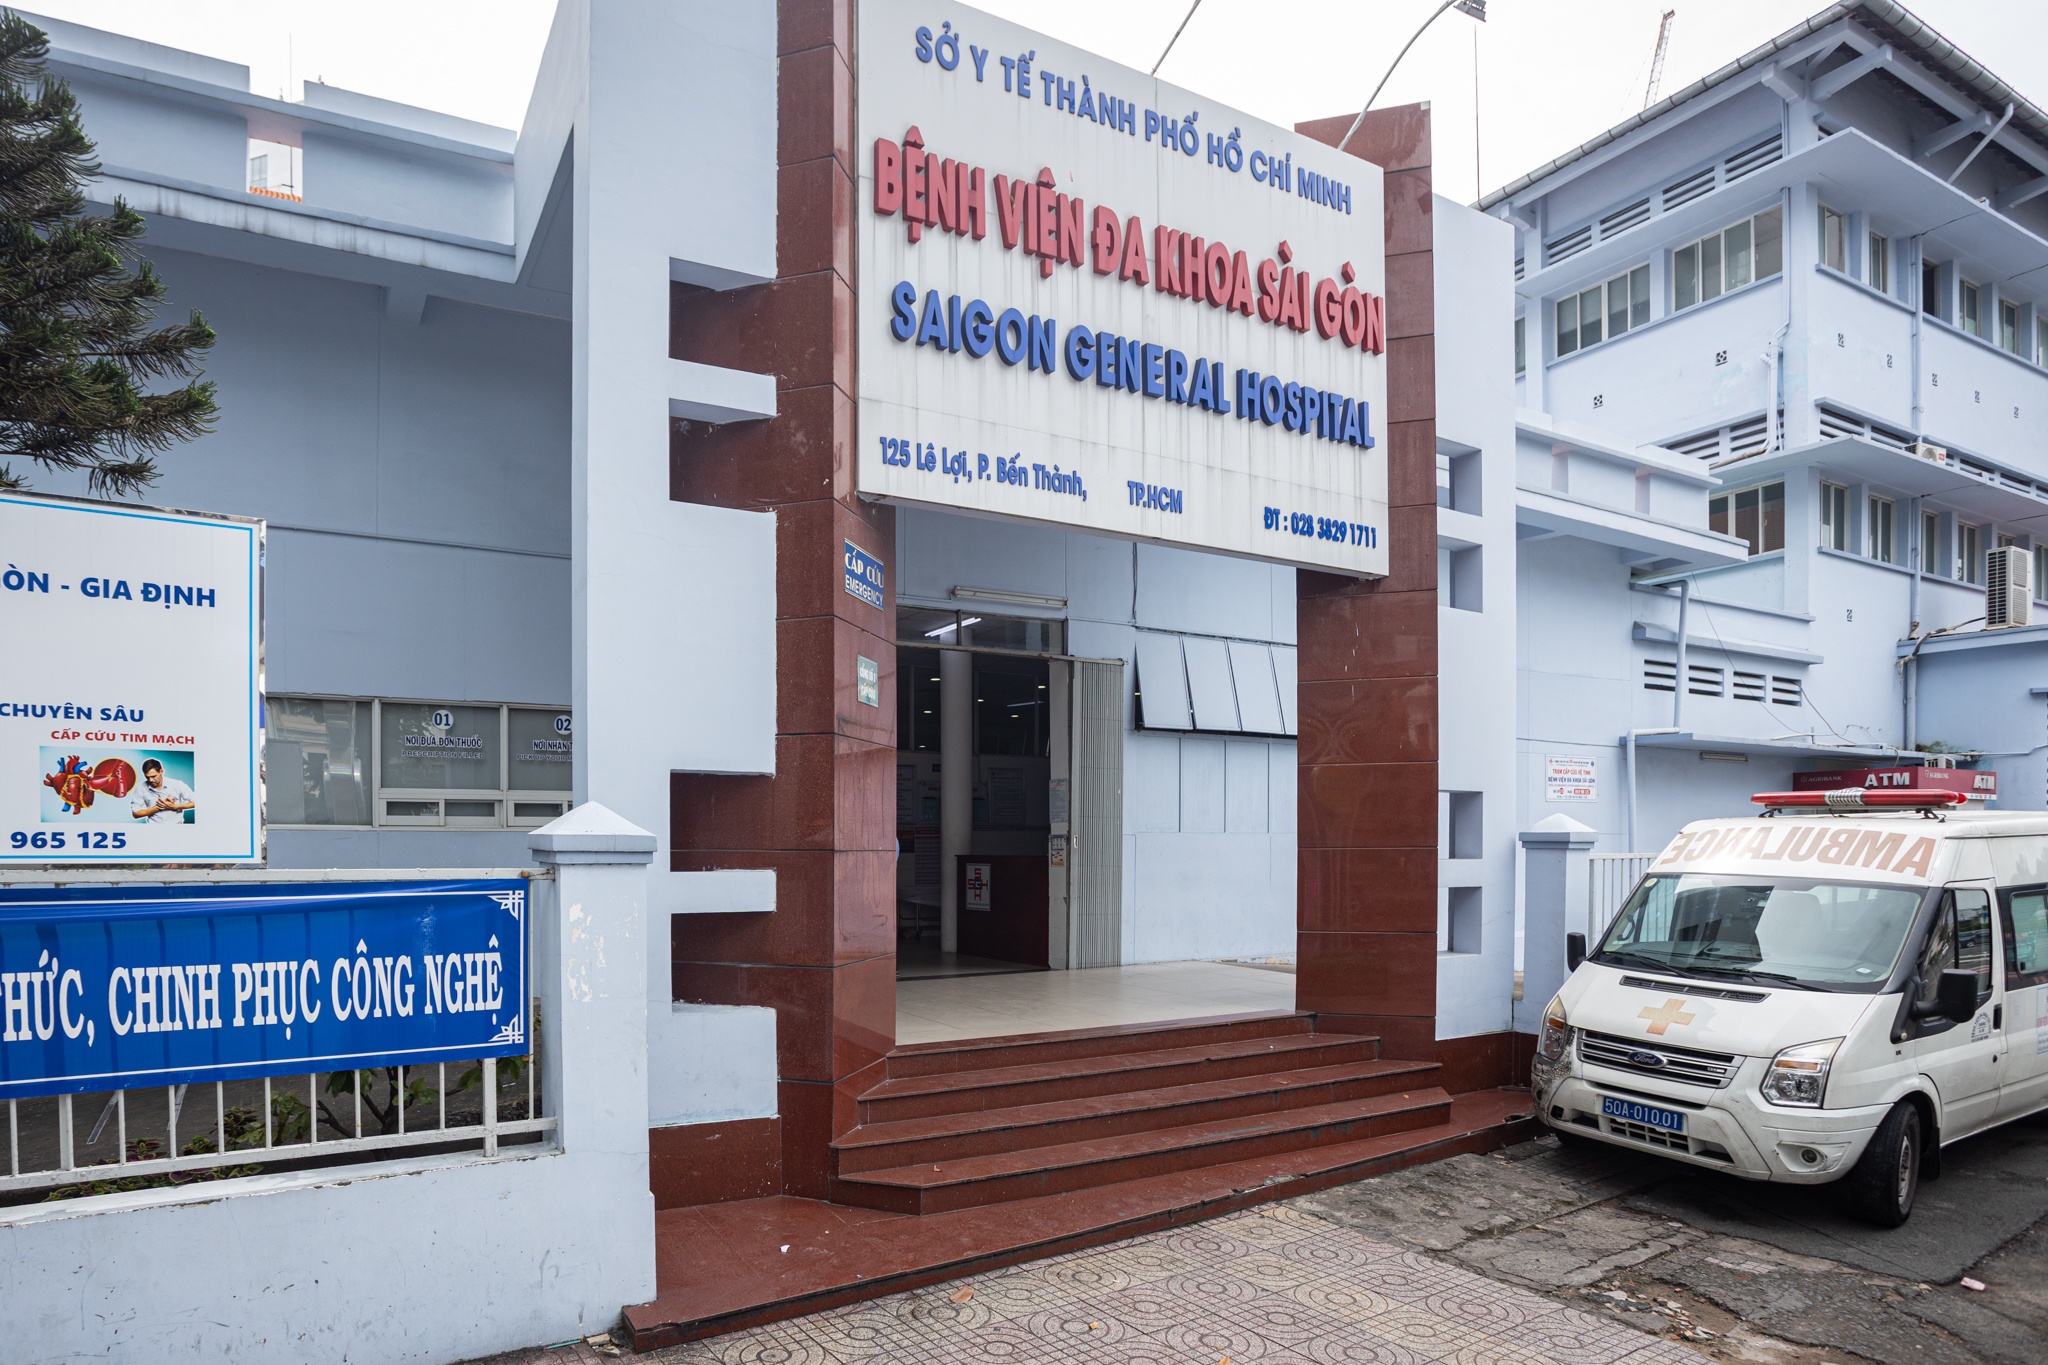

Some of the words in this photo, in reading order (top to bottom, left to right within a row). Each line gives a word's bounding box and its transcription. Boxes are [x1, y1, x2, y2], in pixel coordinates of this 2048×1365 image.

[915, 21, 960, 71] SỞ
[970, 45, 989, 82] Y
[1000, 50, 1036, 98] TẾ
[1041, 75, 1136, 136] THÀNH
[1145, 111, 1199, 156] PHỐ
[1207, 127, 1244, 172] HỒ
[1250, 153, 1292, 192] CHÍ
[1298, 167, 1351, 215] MINH
[874, 125, 986, 244] BỆNH
[993, 166, 1085, 279] VIỆN
[1091, 205, 1150, 286] ĐA
[1155, 225, 1255, 317] KHOA
[1257, 240, 1311, 333] SÀI
[1314, 261, 1385, 355] GÒN
[890, 280, 1056, 374] SAIGON
[1065, 324, 1231, 415] GENERAL
[1236, 368, 1376, 449] HOSPITAL
[880, 437, 911, 467] 125
[917, 443, 937, 472] Lê
[942, 447, 973, 483] Lợi,
[978, 453, 992, 481] P.
[997, 452, 1029, 487] Bến
[1033, 463, 1088, 501] Thành,
[1127, 480, 1183, 514] TP.HCM
[1264, 506, 1280, 531] ĐT
[1291, 512, 1315, 537] 028
[1317, 517, 1348, 543] 3829
[1350, 523, 1377, 549] 1711
[844, 549, 864, 576] CẤP
[866, 565, 884, 589] CỨU
[0, 563, 49, 593] ÒN
[80, 577, 133, 600] GIA
[140, 582, 215, 609] ĐỊNH
[845, 574, 884, 607] EMERGENCY
[0, 702, 92, 720] CHUYÊN
[100, 705, 144, 722] SÂU
[434, 712, 451, 727] 01
[555, 718, 571, 731] 02
[51, 728, 81, 740] CẤP
[85, 730, 116, 742] CỨU
[120, 733, 147, 743] TIM
[152, 735, 195, 746] MẠCH
[456, 734, 483, 749] THUỐC
[401, 750, 457, 758] PRESCRIPTION
[1865, 772, 1910, 787] ATM
[1973, 774, 1995, 790] ATM
[10, 832, 66, 849] 965
[77, 832, 127, 849] 125
[0, 949, 95, 1048] HỨC,
[108, 964, 223, 1036] CHINH
[232, 959, 321, 1040] PHỤC
[331, 938, 415, 1021] CÔNG
[424, 934, 504, 1025] NGHỆ
[1633, 1052, 1656, 1064] Ford
[1605, 1098, 1678, 1128] 50A-010.01
